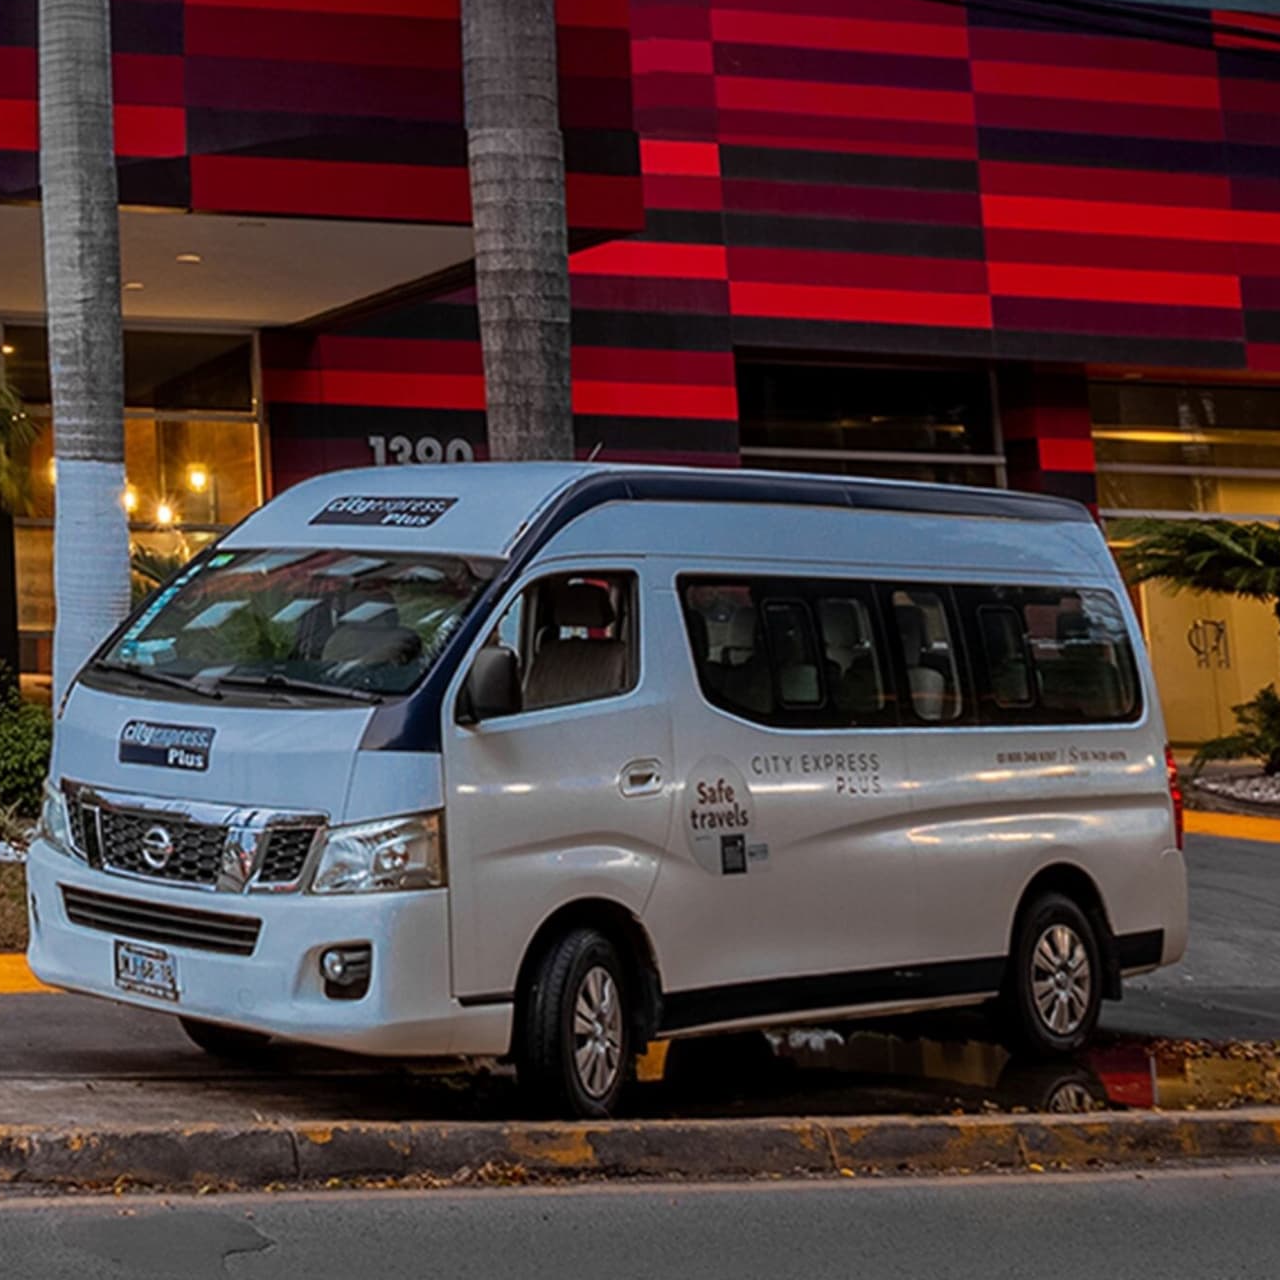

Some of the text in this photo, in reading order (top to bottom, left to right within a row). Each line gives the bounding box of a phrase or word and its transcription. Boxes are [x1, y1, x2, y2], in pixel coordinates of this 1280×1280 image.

[381, 513, 432, 525] Plus
[167, 748, 204, 768] Plus
[752, 756, 793, 774] CITY
[802, 753, 880, 773] EXPRESS
[697, 778, 734, 804] Safe
[836, 776, 881, 794] PLUS
[691, 803, 749, 829] travels
